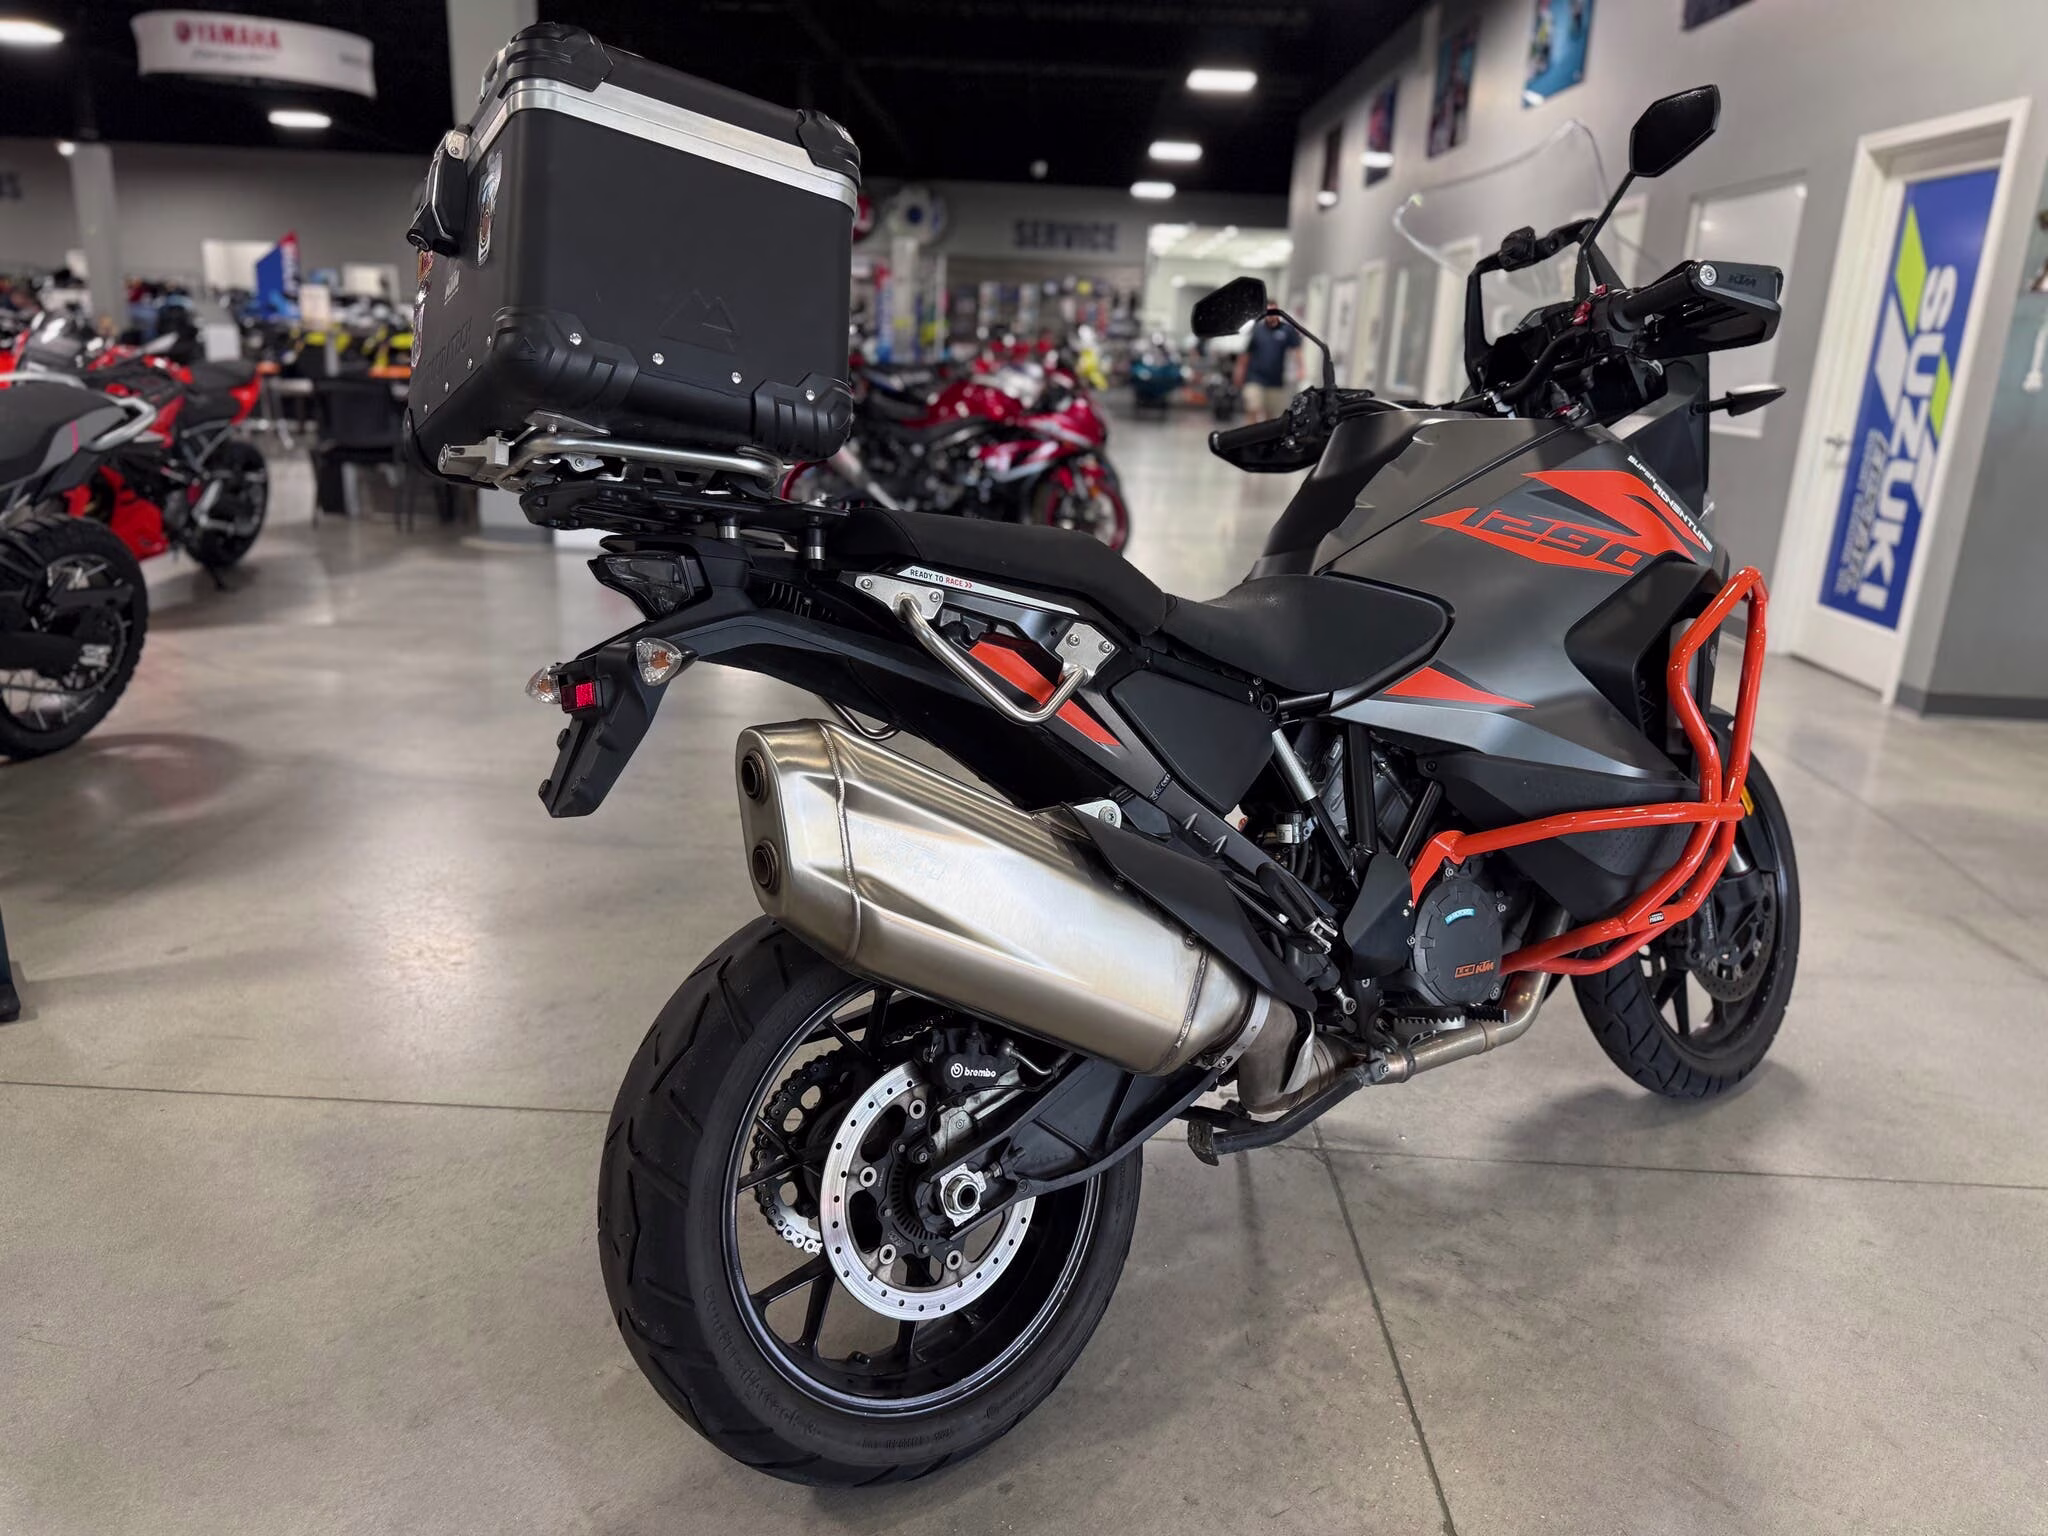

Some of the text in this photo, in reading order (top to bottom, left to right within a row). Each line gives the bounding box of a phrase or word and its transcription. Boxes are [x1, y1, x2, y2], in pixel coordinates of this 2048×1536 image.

[197, 22, 282, 51] YAMAHA
[1014, 219, 1119, 253] SERVICE
[1857, 265, 1957, 611] SUZUKI
[1627, 455, 1713, 552] SUPER ADVENTURE
[1460, 508, 1655, 571] 1290
[910, 568, 964, 587] READY TO RACE
[1476, 960, 1494, 974] KTM
[964, 1066, 997, 1078] brembo
